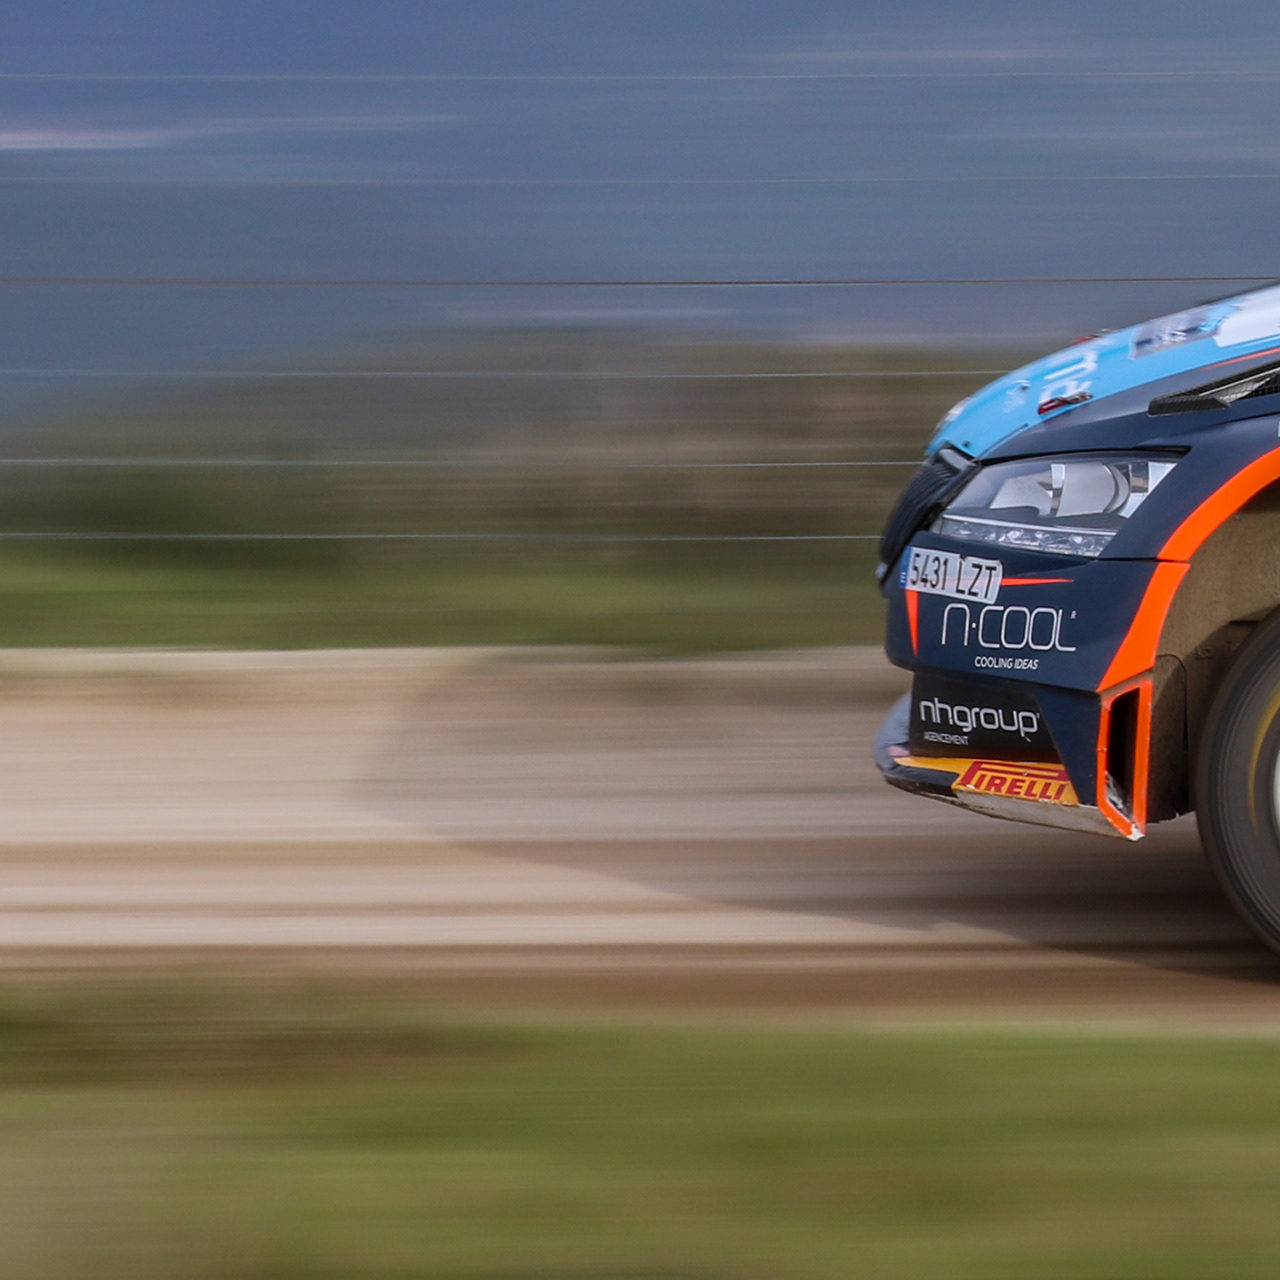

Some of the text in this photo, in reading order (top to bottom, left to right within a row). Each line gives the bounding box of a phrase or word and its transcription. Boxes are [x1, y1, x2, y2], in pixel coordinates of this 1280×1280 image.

[910, 552, 998, 600] 5431 LZT
[974, 656, 1039, 671] COOLING IDEAS
[919, 697, 1039, 738] nhgroup
[922, 731, 969, 746] AGENCEMENT
[959, 760, 1071, 801] PIRELLI
